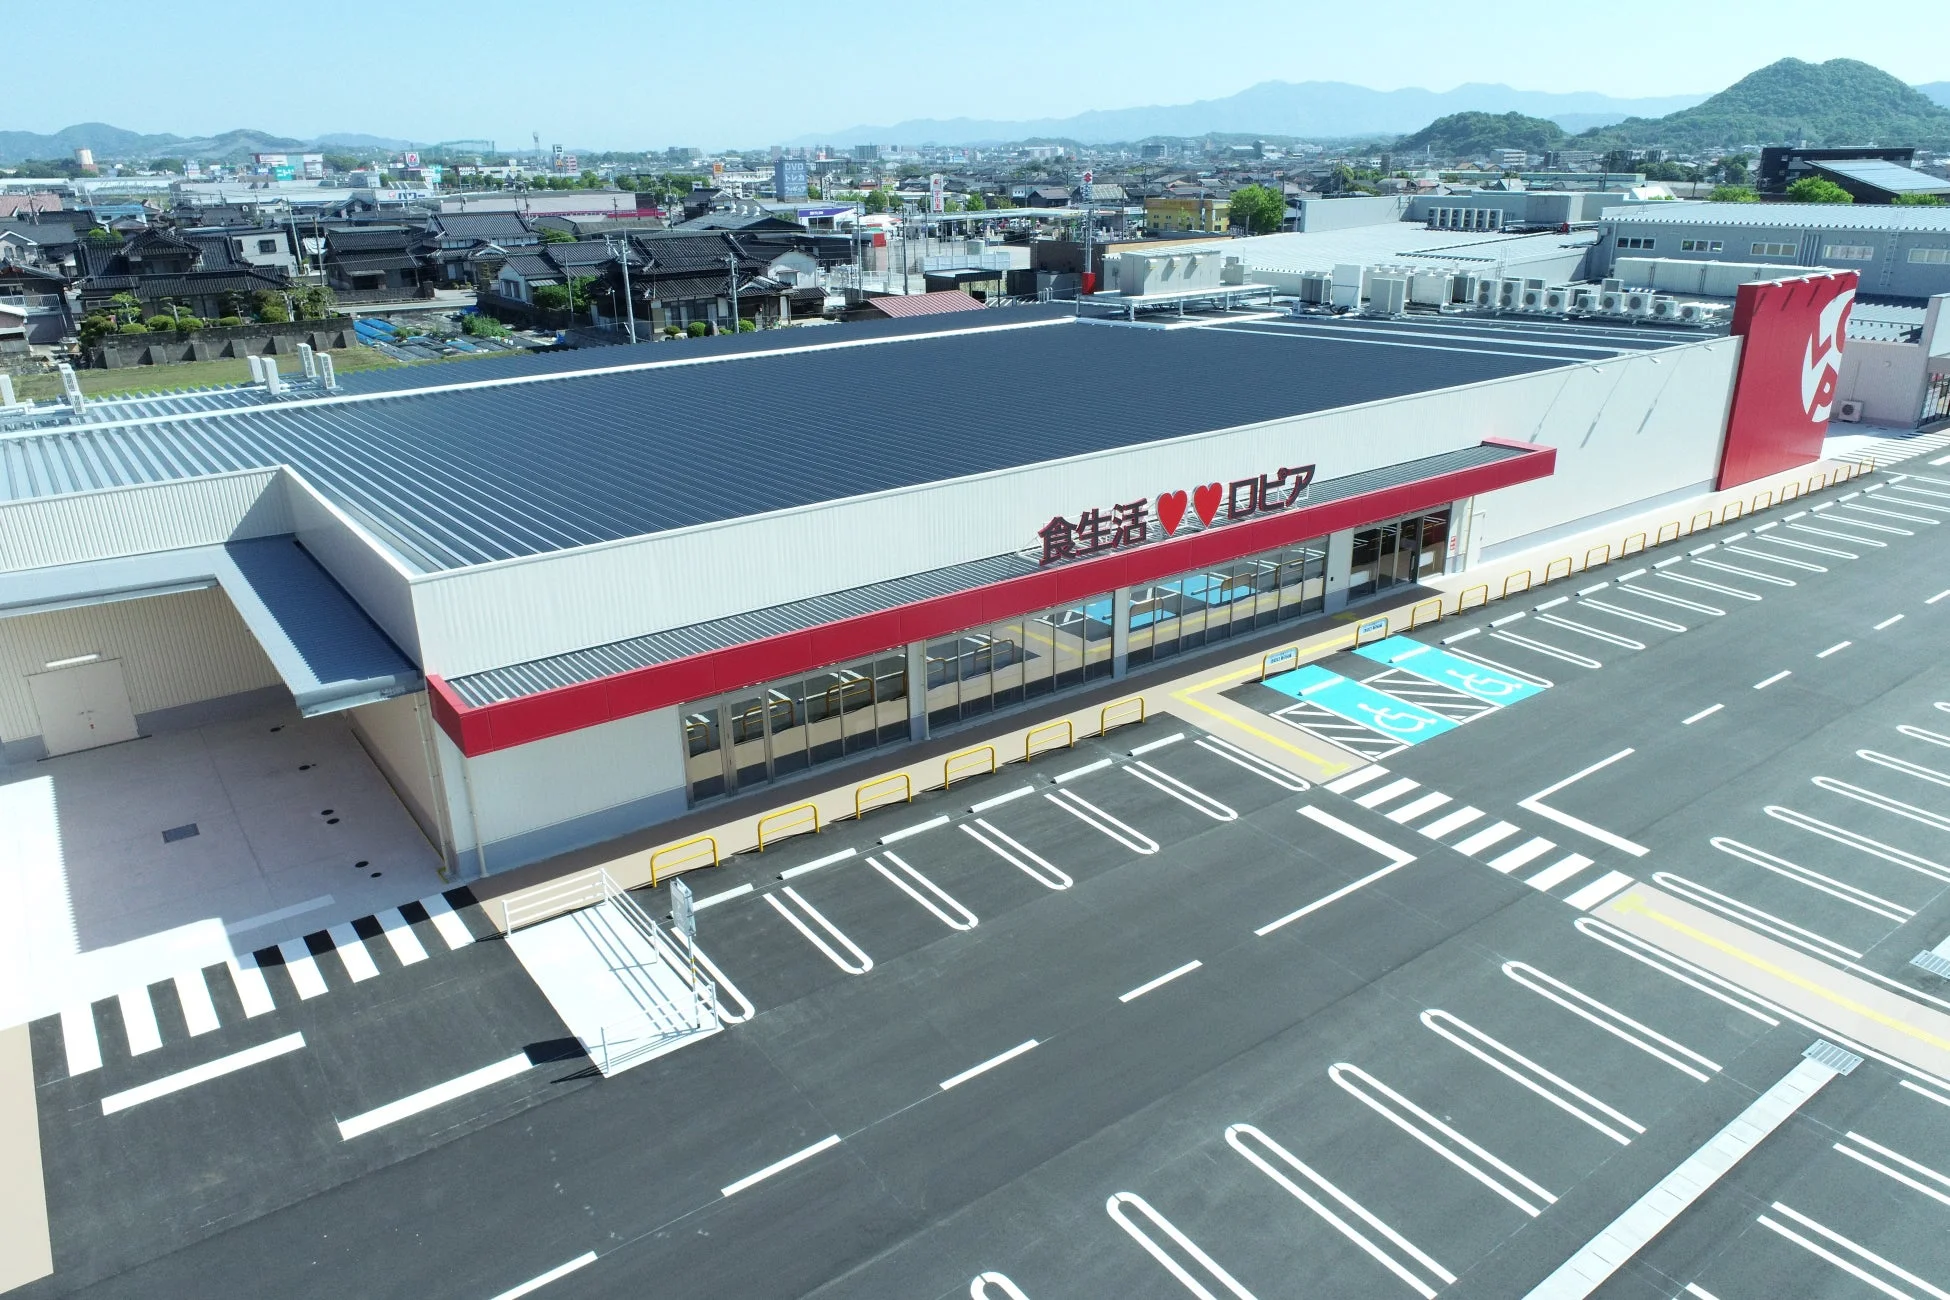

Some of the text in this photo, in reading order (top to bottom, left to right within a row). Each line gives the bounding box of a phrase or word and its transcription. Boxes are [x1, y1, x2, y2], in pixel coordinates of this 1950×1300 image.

[784, 163, 804, 171] DVD
[785, 173, 805, 182] トレカ
[1038, 464, 1316, 566] 食生活 ロピア
